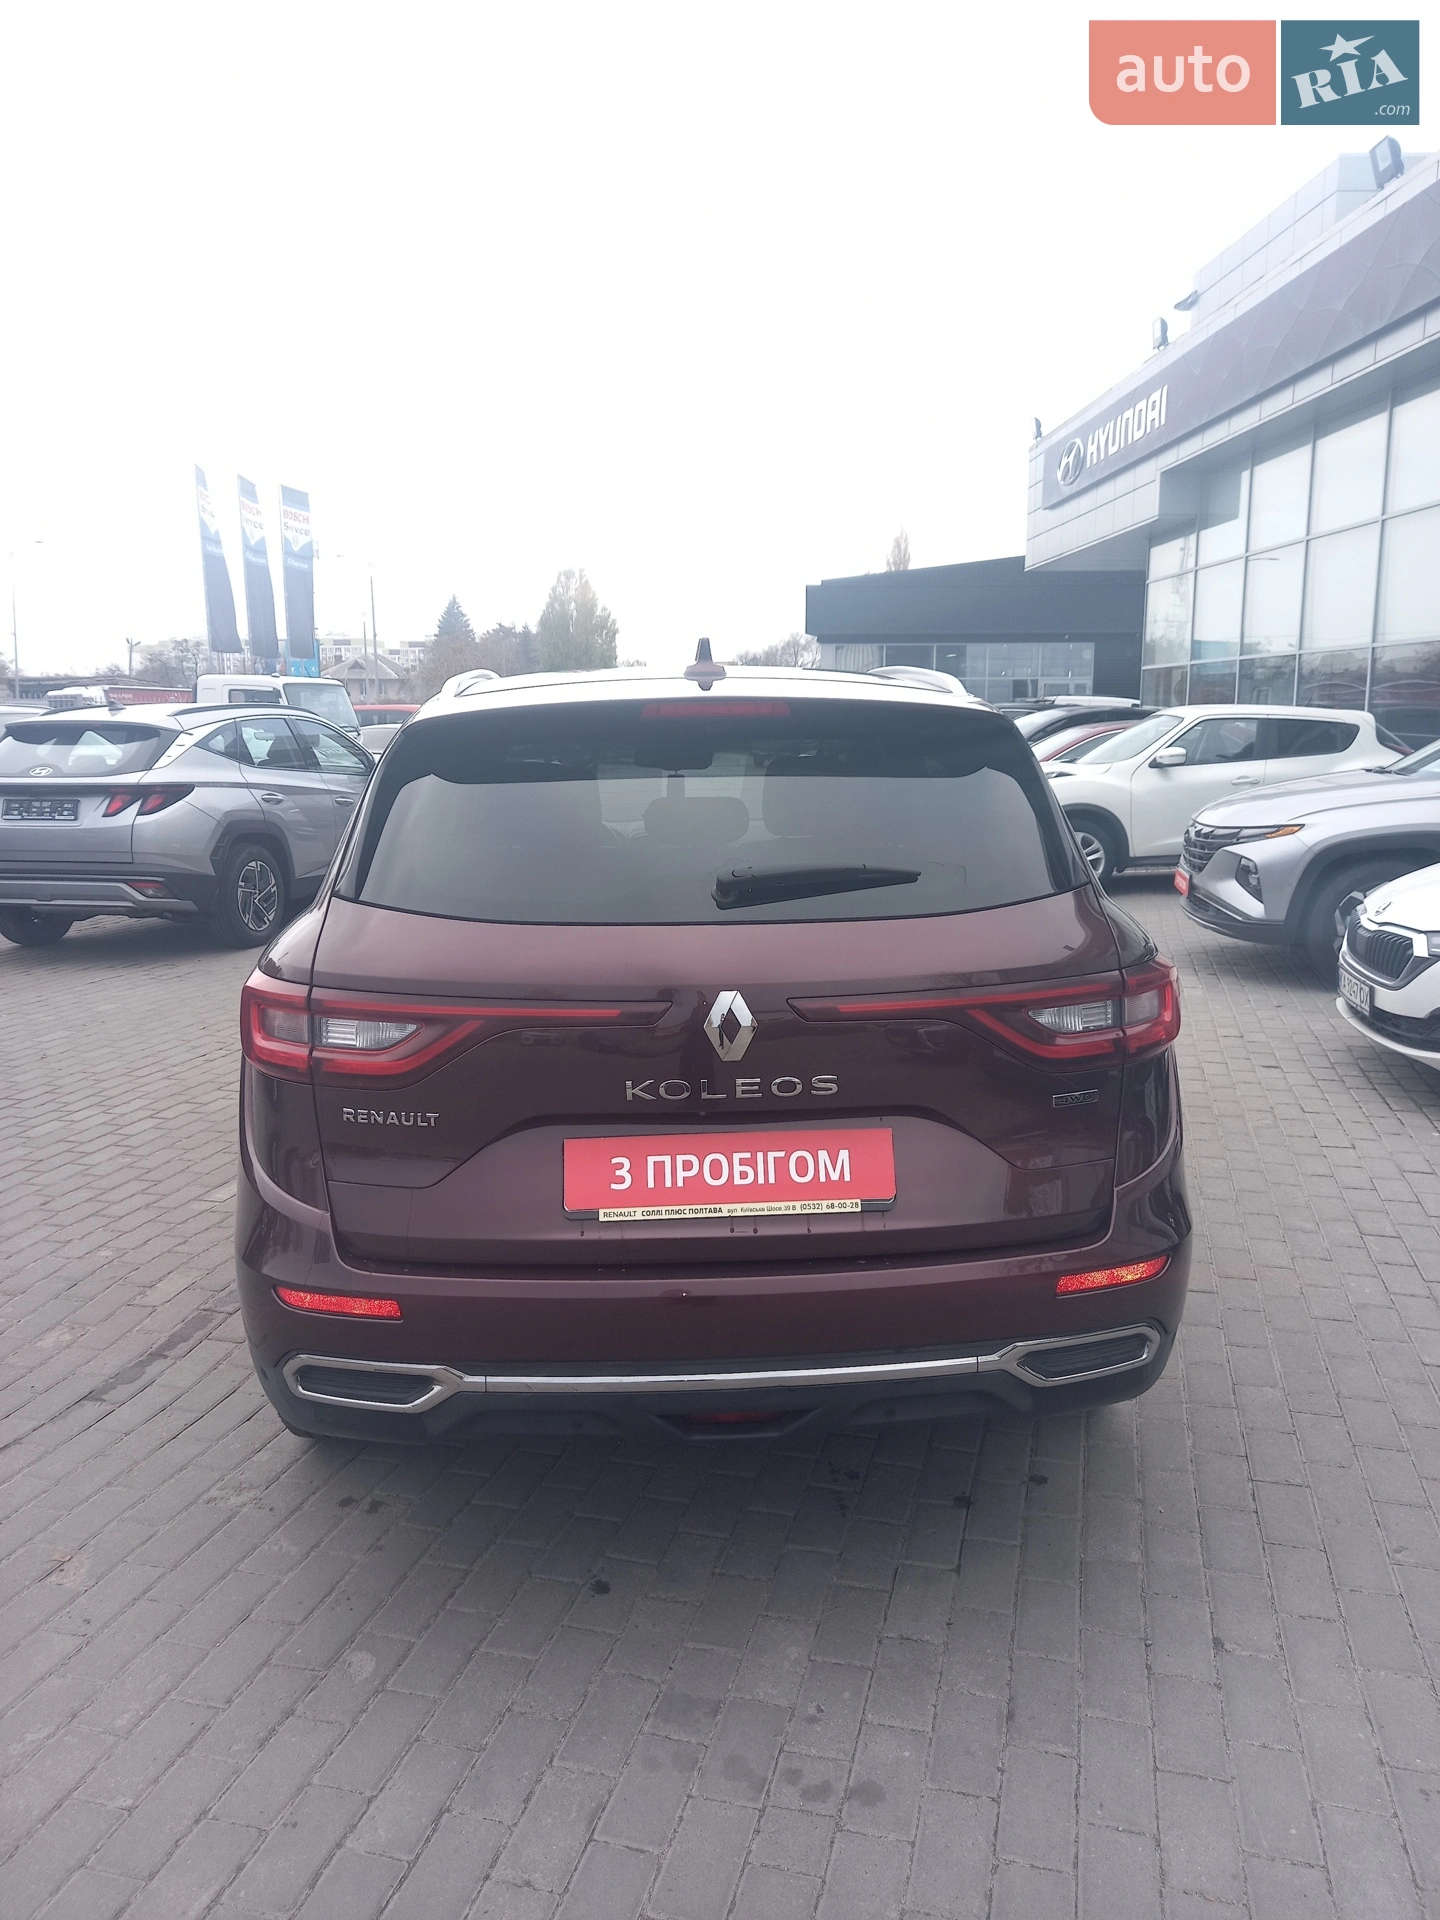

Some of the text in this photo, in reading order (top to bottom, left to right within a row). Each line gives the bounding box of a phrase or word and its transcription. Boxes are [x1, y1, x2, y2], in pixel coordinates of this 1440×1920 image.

[1086, 384, 1168, 469] HYUNDAI
[283, 508, 310, 525] BOSCH
[624, 1075, 840, 1101] KOLEOS
[342, 1107, 440, 1127] RENAULT
[609, 1149, 852, 1191] З ПРОБІГОМ
[603, 1210, 638, 1219] RENAULT
[641, 1209, 664, 1217] СОЛЛІ
[664, 1207, 688, 1216] ПЛЮС
[688, 1206, 724, 1215] ПОЛТАВА
[799, 1202, 824, 1212] (0532)
[825, 1201, 860, 1210] 68-00-28
